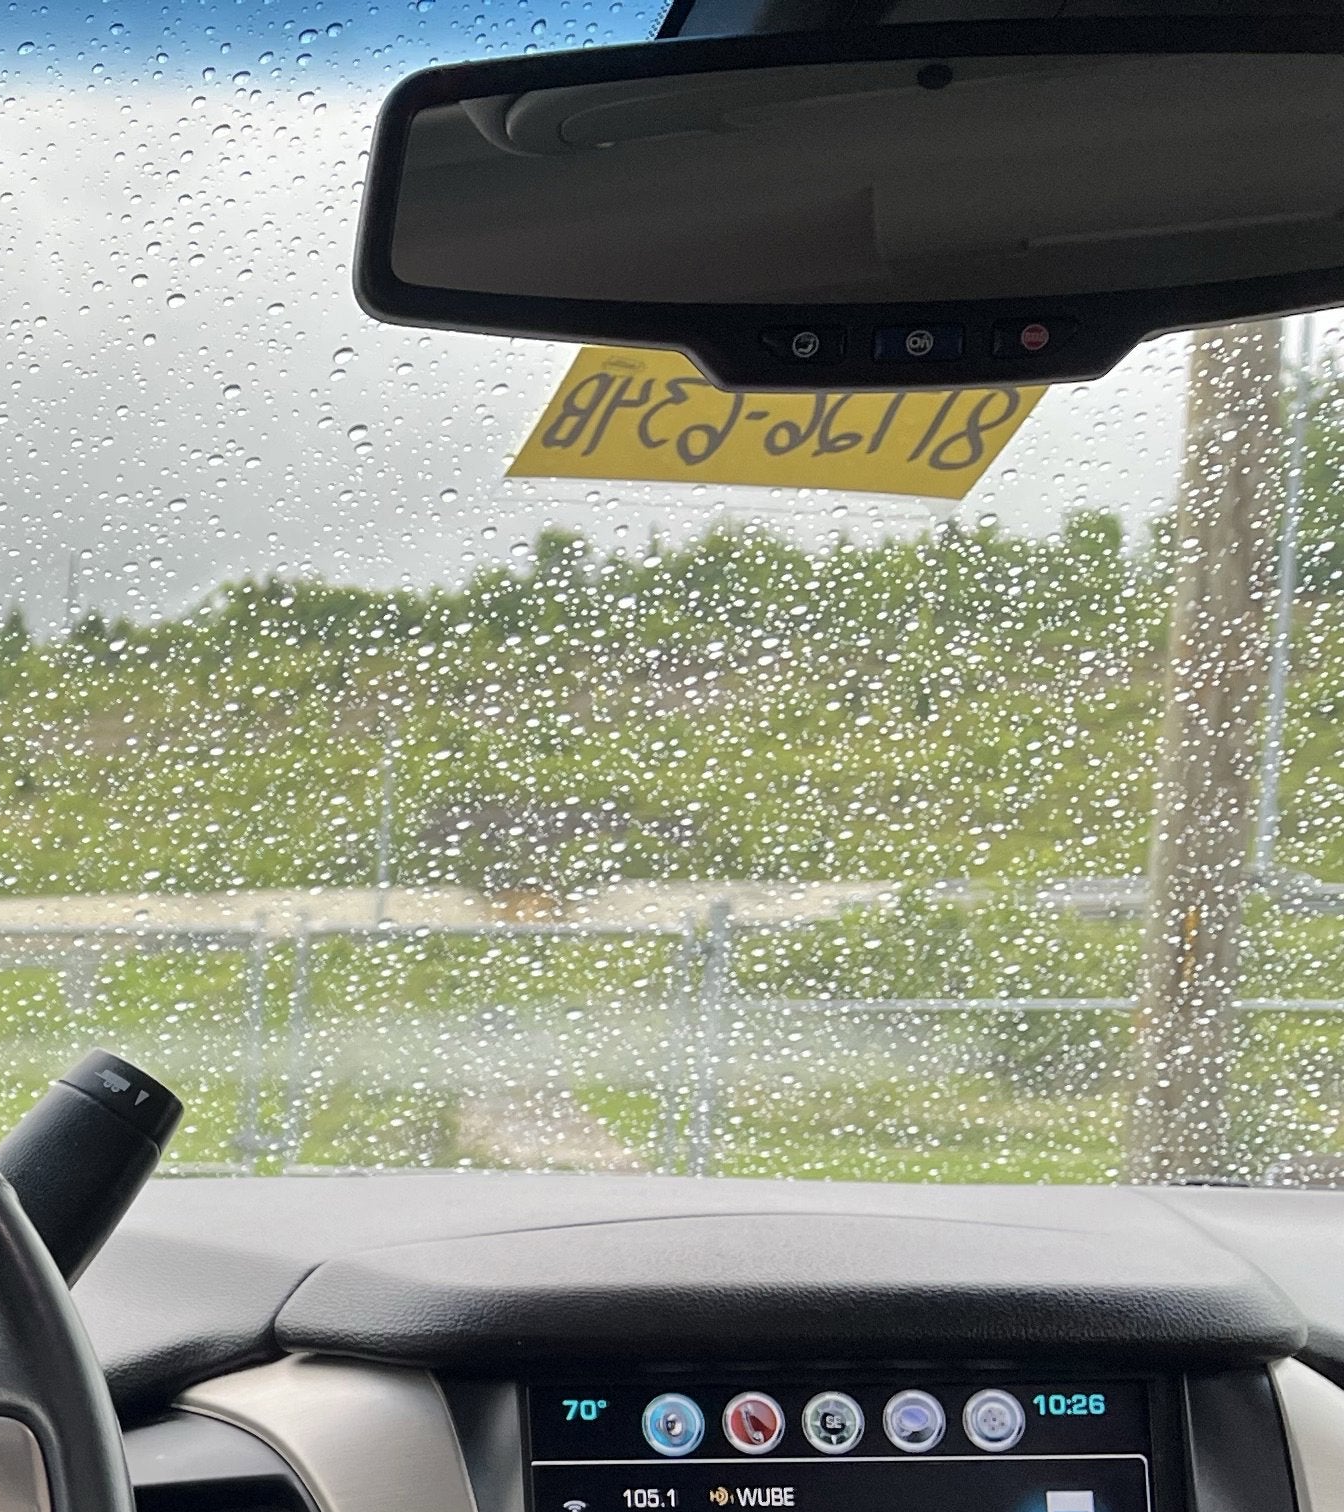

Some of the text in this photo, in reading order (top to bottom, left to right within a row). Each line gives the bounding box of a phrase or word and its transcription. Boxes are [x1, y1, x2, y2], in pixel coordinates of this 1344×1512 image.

[562, 1399, 607, 1421] 70°
[1033, 1394, 1106, 1416] 10:26
[623, 1488, 677, 1508] 105.1
[736, 1487, 795, 1507] WUBE
